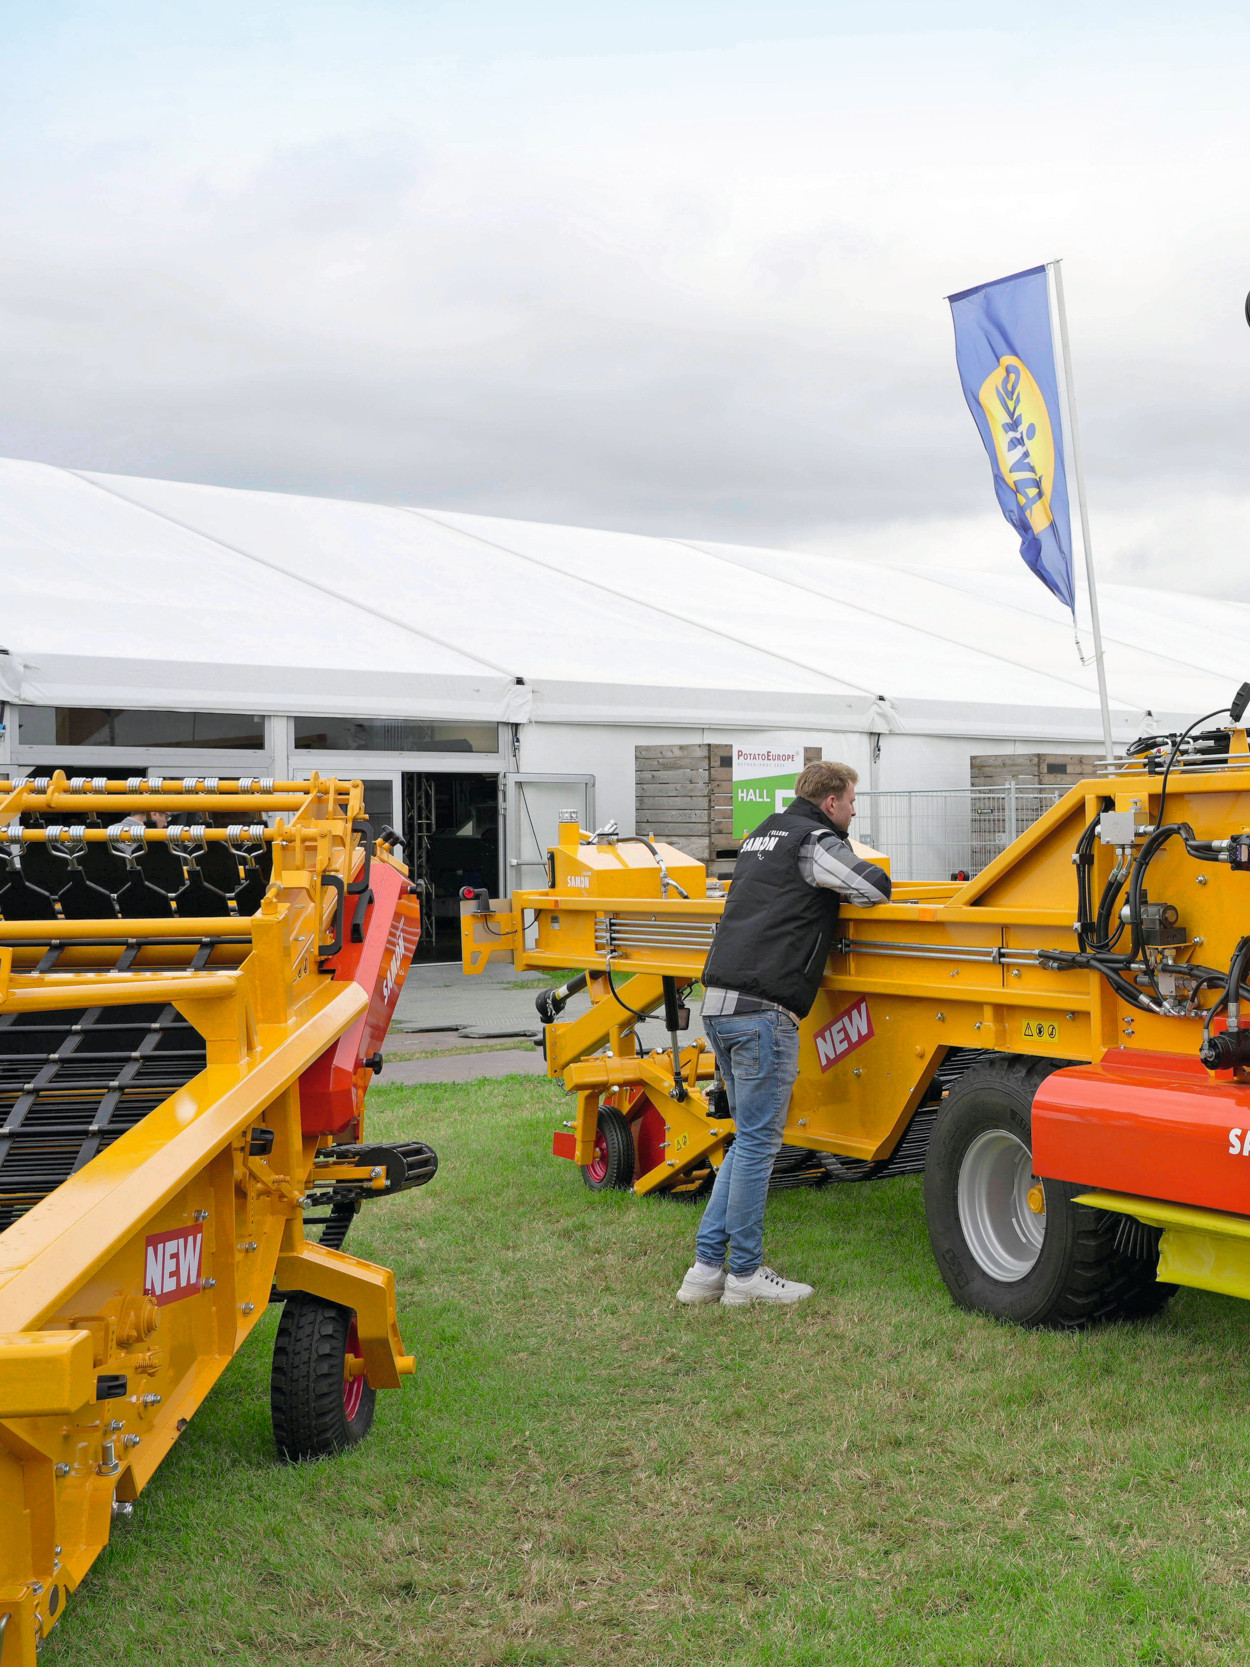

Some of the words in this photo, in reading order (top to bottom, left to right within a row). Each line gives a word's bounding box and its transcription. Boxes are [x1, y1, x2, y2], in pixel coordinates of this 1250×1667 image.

[738, 788, 771, 802] HALL
[740, 836, 779, 853] SAMON
[567, 875, 590, 888] SAMON
[816, 1001, 868, 1067] NEW
[145, 1233, 203, 1296] NEW
